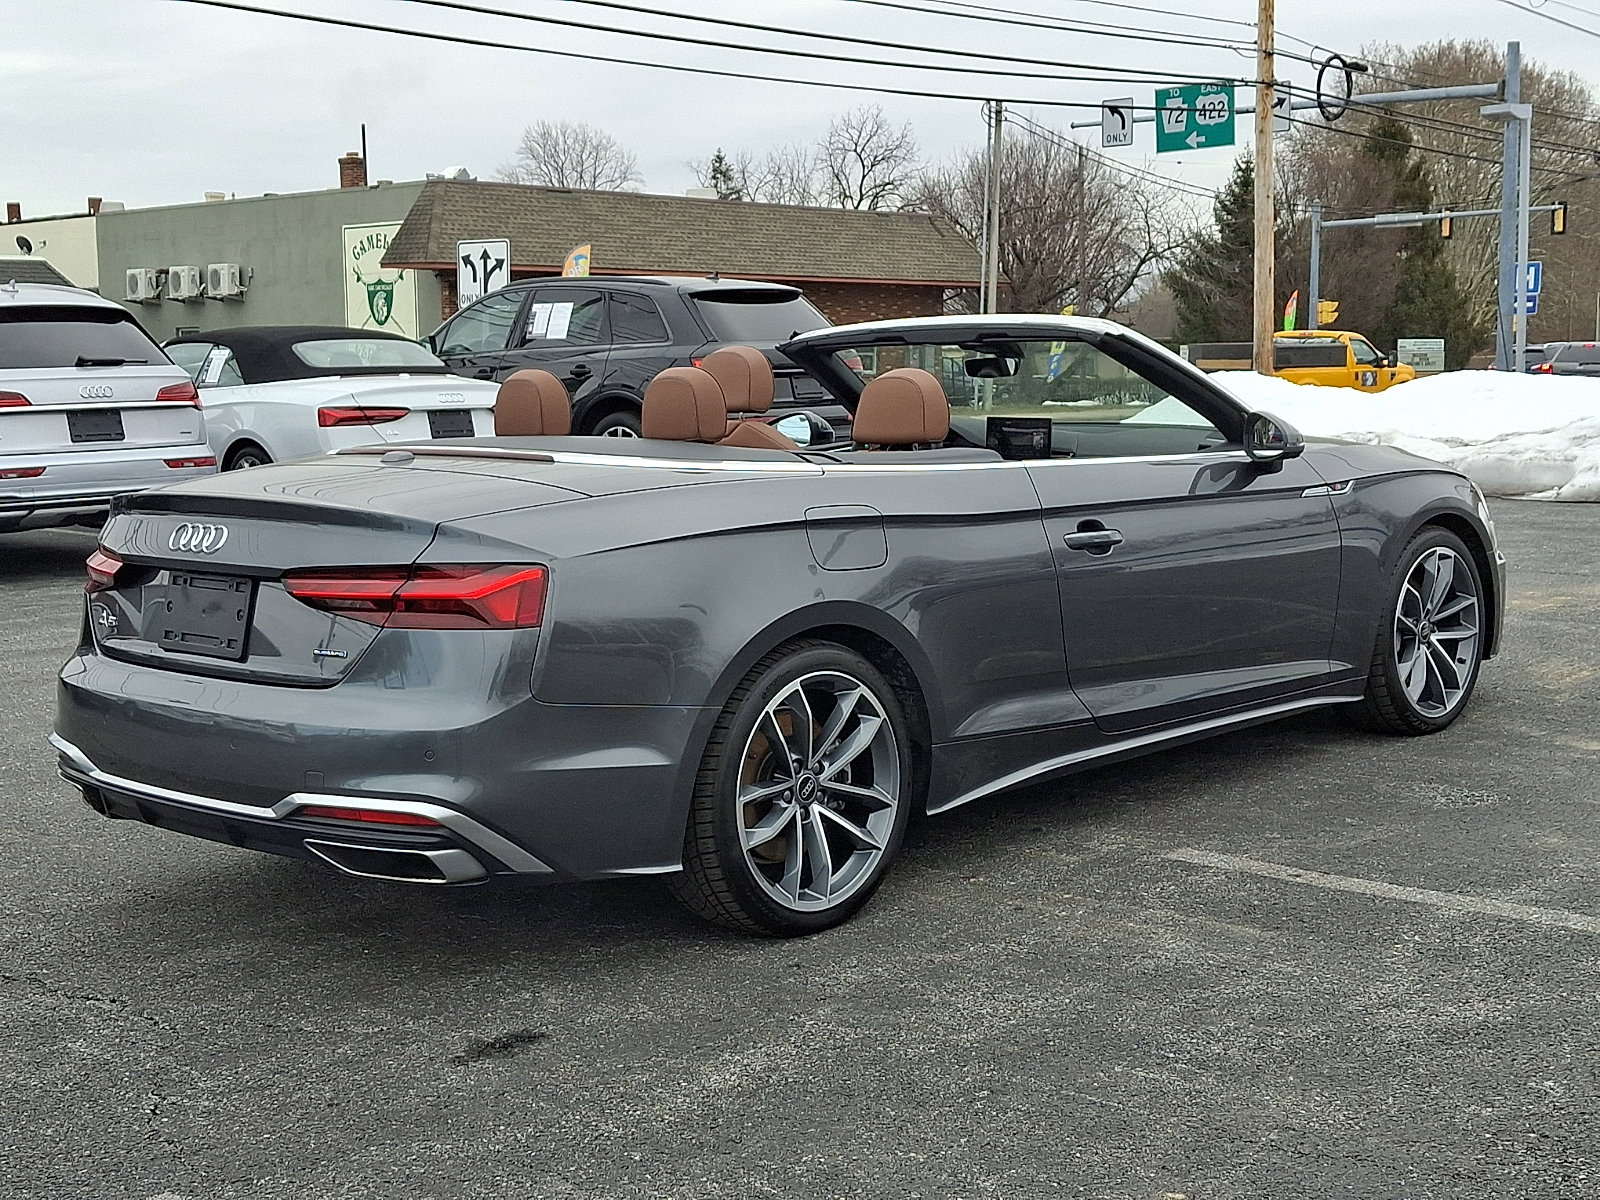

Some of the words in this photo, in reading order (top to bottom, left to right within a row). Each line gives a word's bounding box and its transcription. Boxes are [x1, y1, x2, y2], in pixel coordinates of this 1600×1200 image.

[1169, 89, 1180, 97] TO
[1167, 106, 1184, 125] 72
[1198, 100, 1226, 120] 422
[1106, 133, 1128, 143] ONLY
